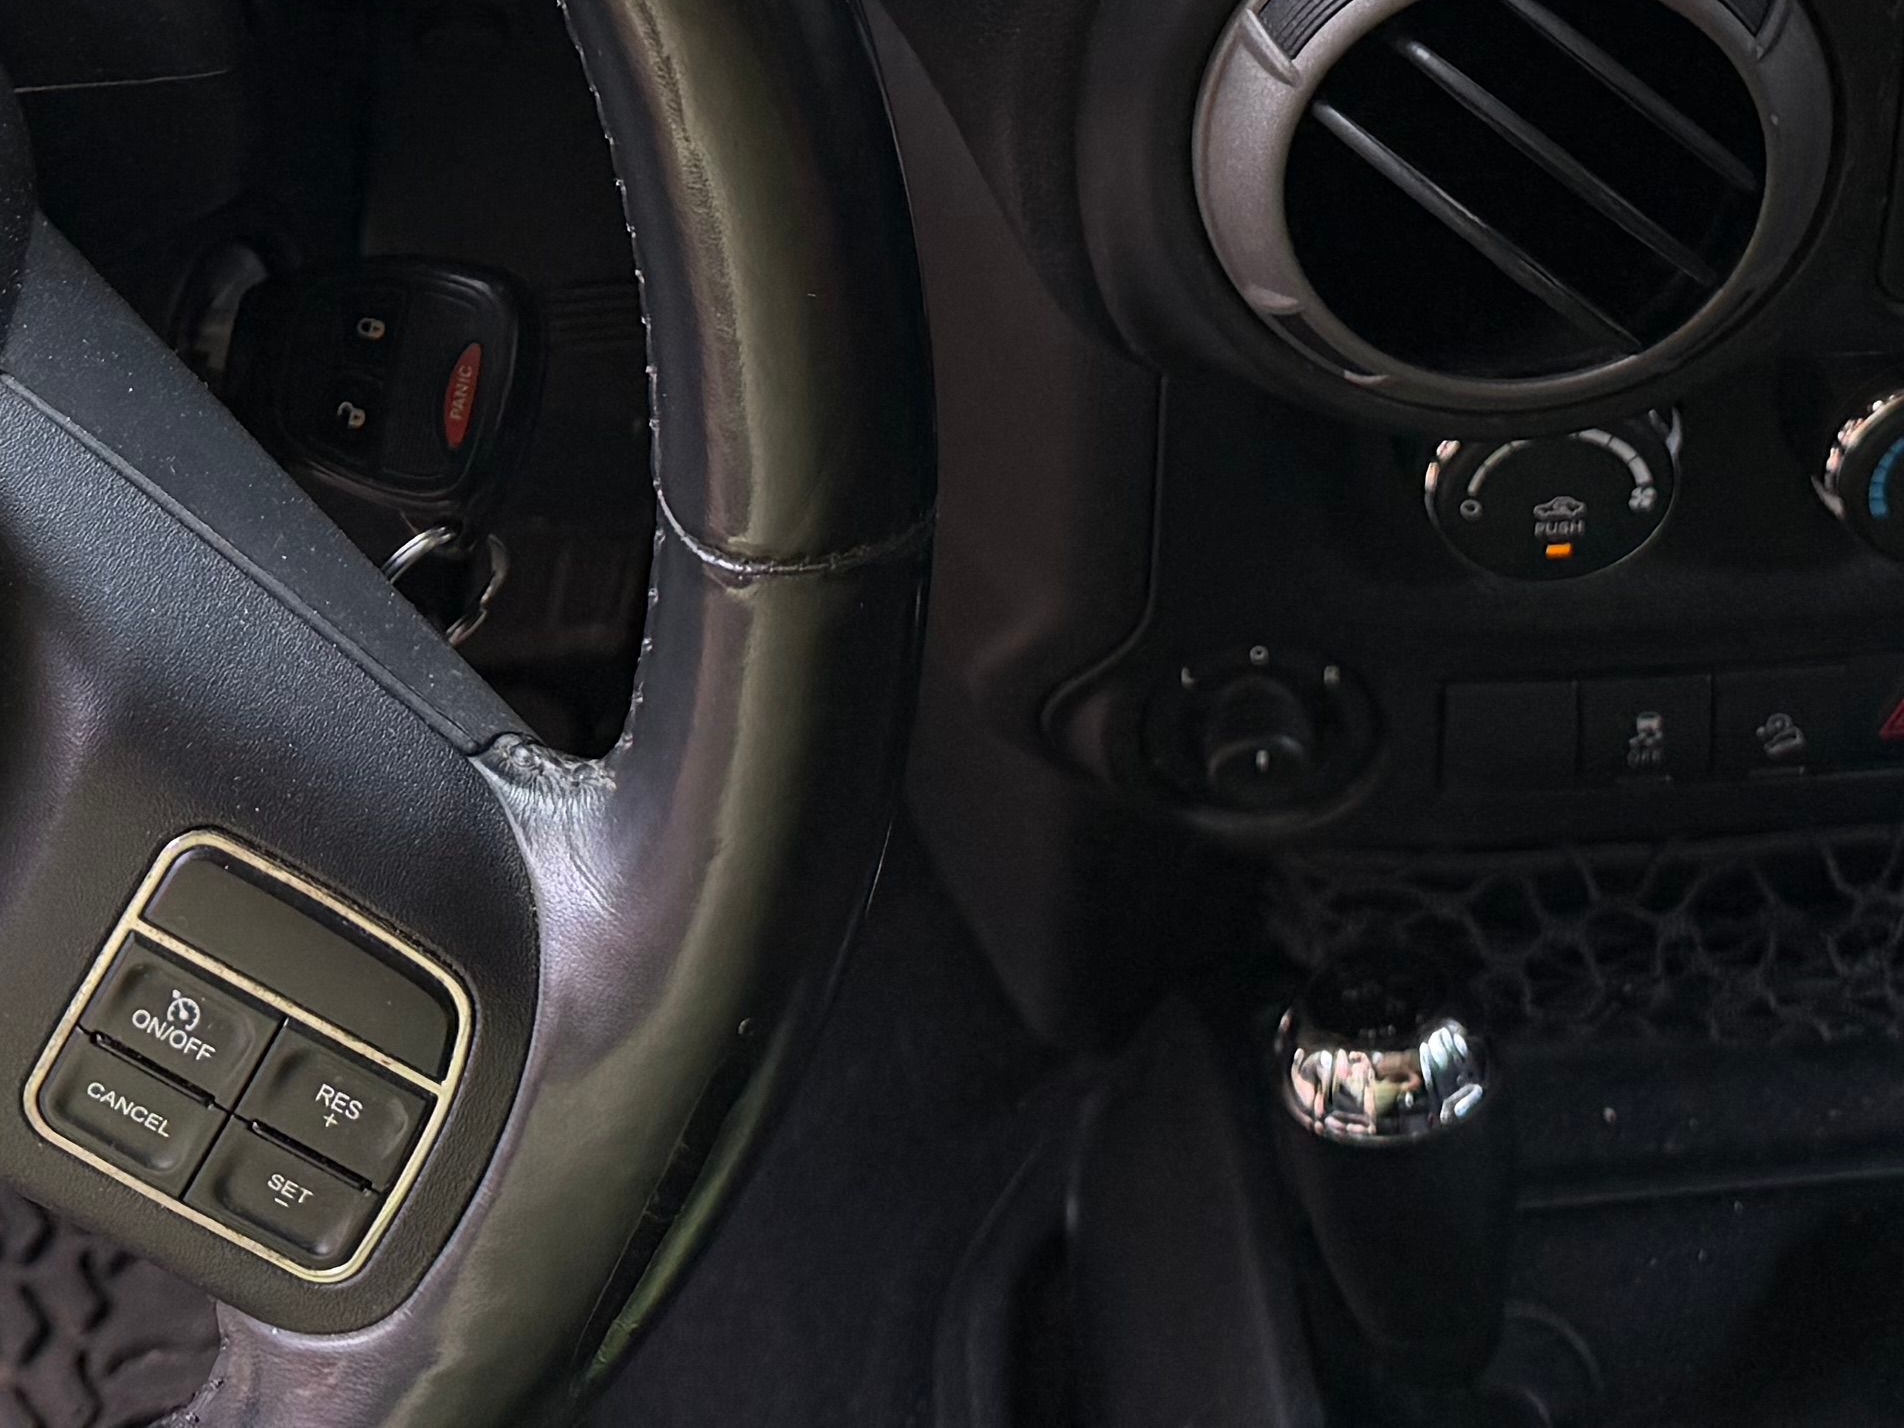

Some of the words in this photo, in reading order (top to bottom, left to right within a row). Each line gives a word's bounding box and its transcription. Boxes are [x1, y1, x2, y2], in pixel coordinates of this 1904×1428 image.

[450, 365, 473, 421] PANIC
[1534, 519, 1585, 536] PUSH
[131, 1008, 216, 1061] ON/OFF
[86, 1081, 171, 1139] CANCEL
[314, 1082, 363, 1121] RES
[266, 1172, 313, 1206] SET
